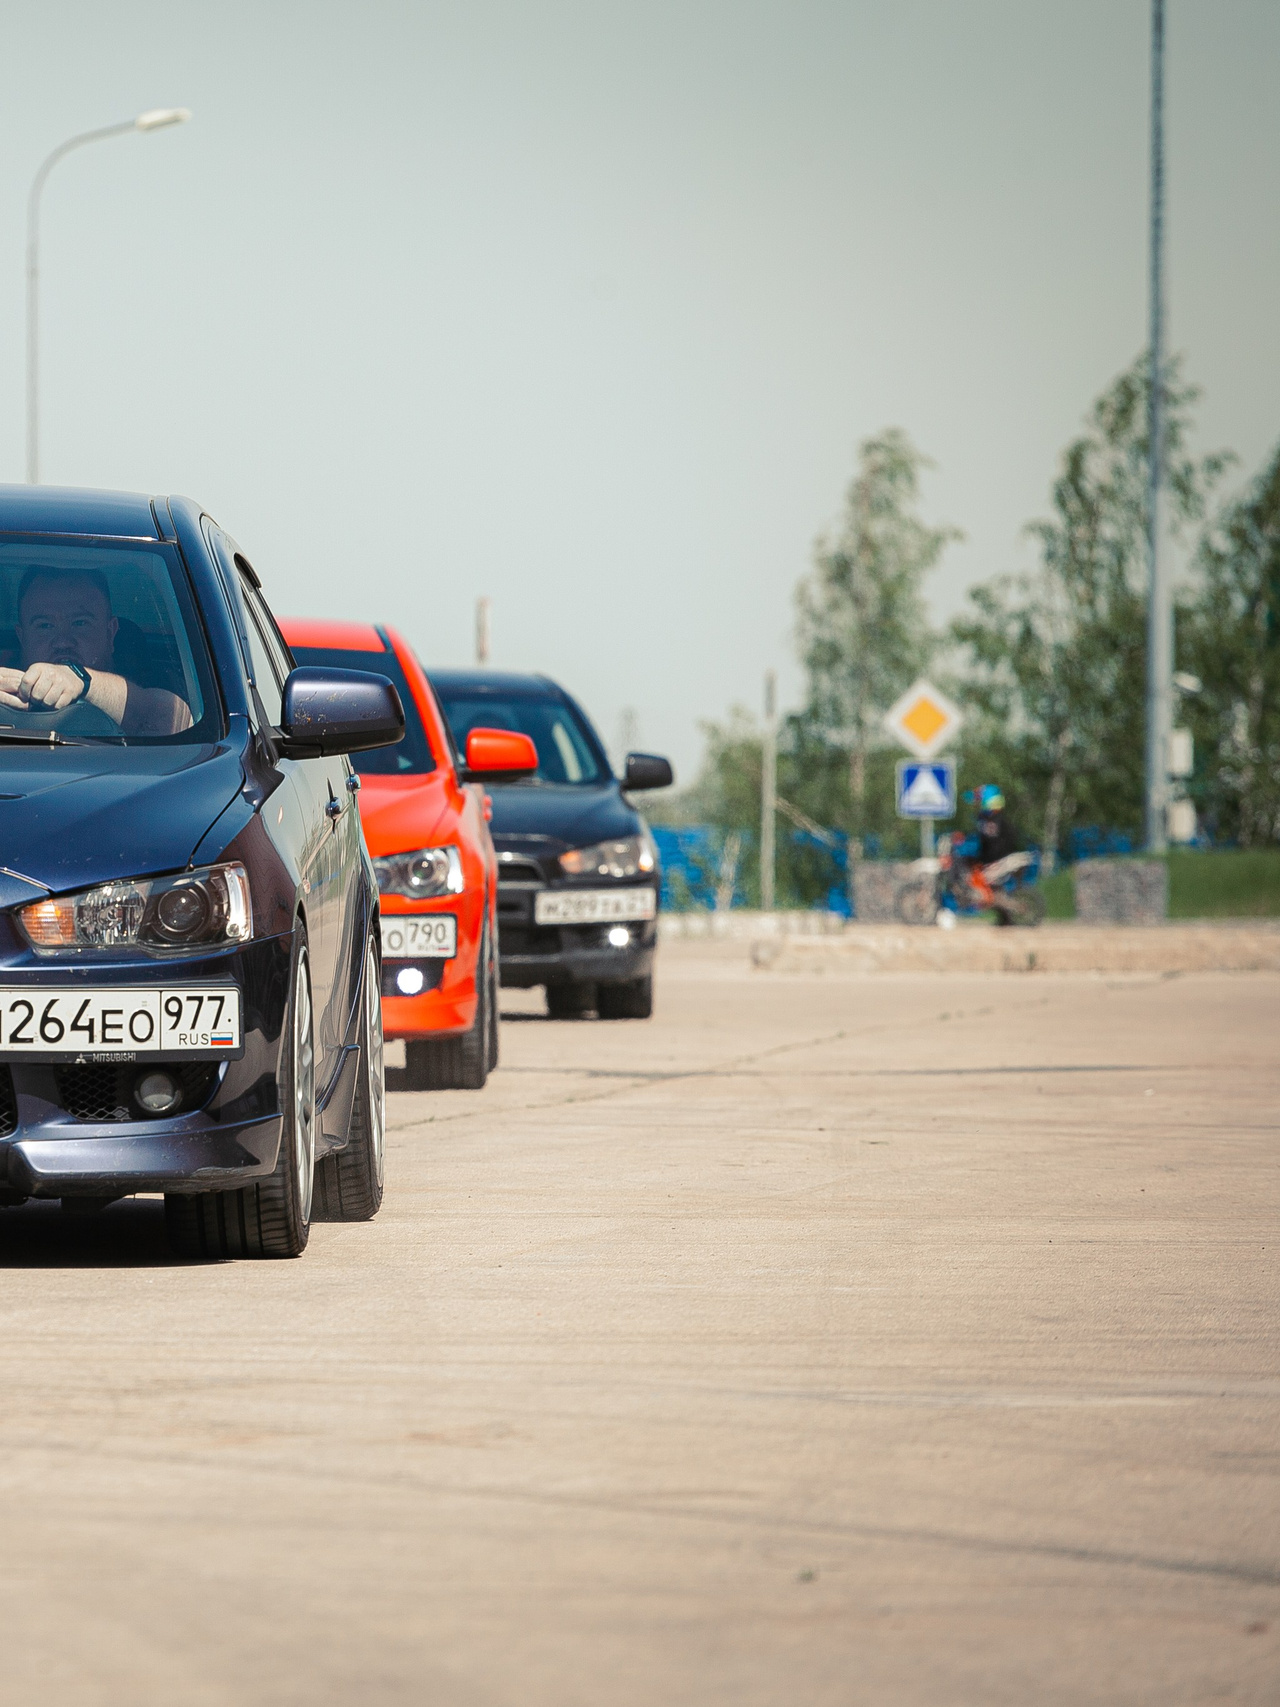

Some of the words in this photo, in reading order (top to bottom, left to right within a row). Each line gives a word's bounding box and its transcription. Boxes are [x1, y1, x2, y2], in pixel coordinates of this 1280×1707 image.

[409, 923, 446, 944] 790
[164, 996, 225, 1030] 977
[179, 1033, 209, 1046] RUS
[92, 1053, 136, 1062] MITSUBISHI
